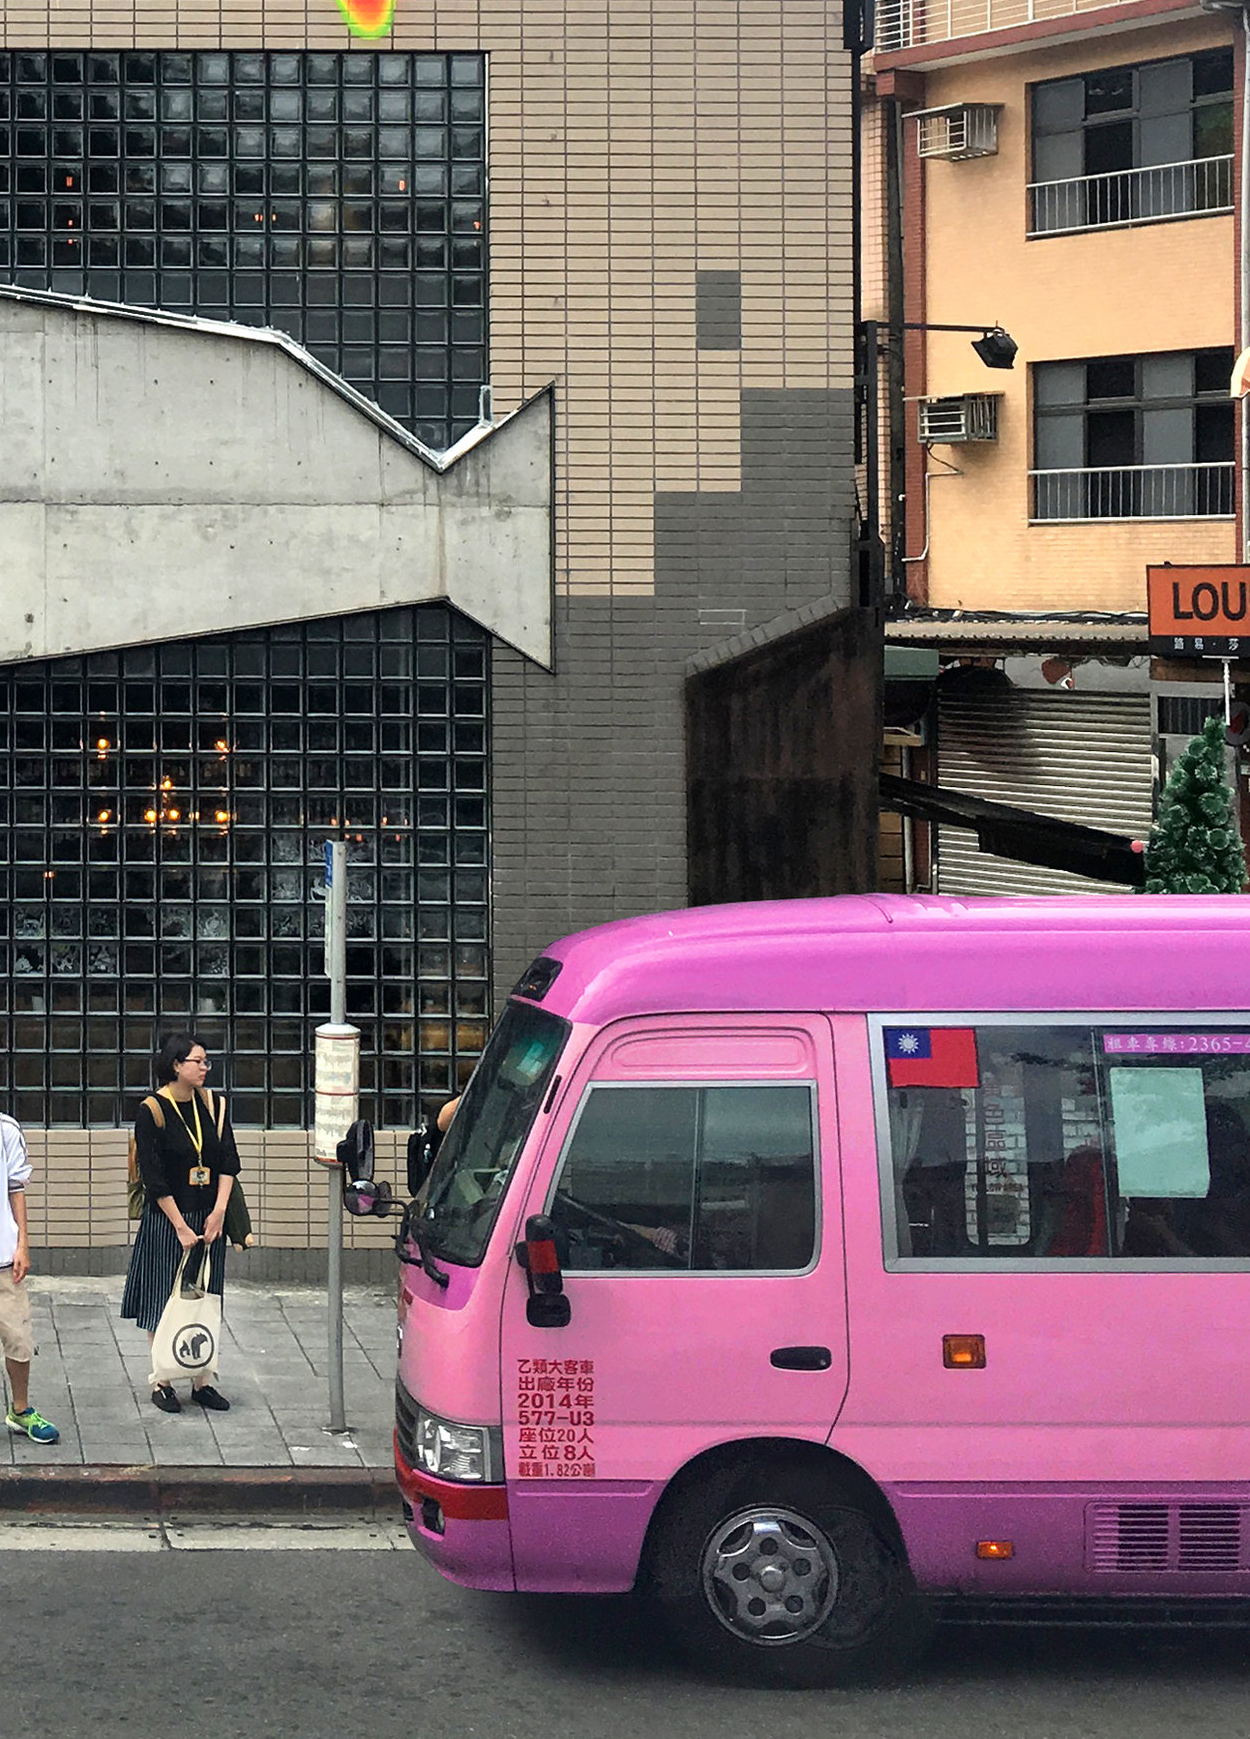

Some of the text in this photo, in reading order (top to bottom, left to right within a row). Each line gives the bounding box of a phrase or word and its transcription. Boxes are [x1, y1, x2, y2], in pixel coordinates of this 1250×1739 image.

[1173, 582, 1247, 621] LOU
[518, 1359, 594, 1375] 乙類大客車
[518, 1393, 594, 1409] 2014年
[518, 1411, 594, 1426] 577-U3
[519, 1427, 594, 1444] 座位20人
[519, 1444, 594, 1461] 立位8人
